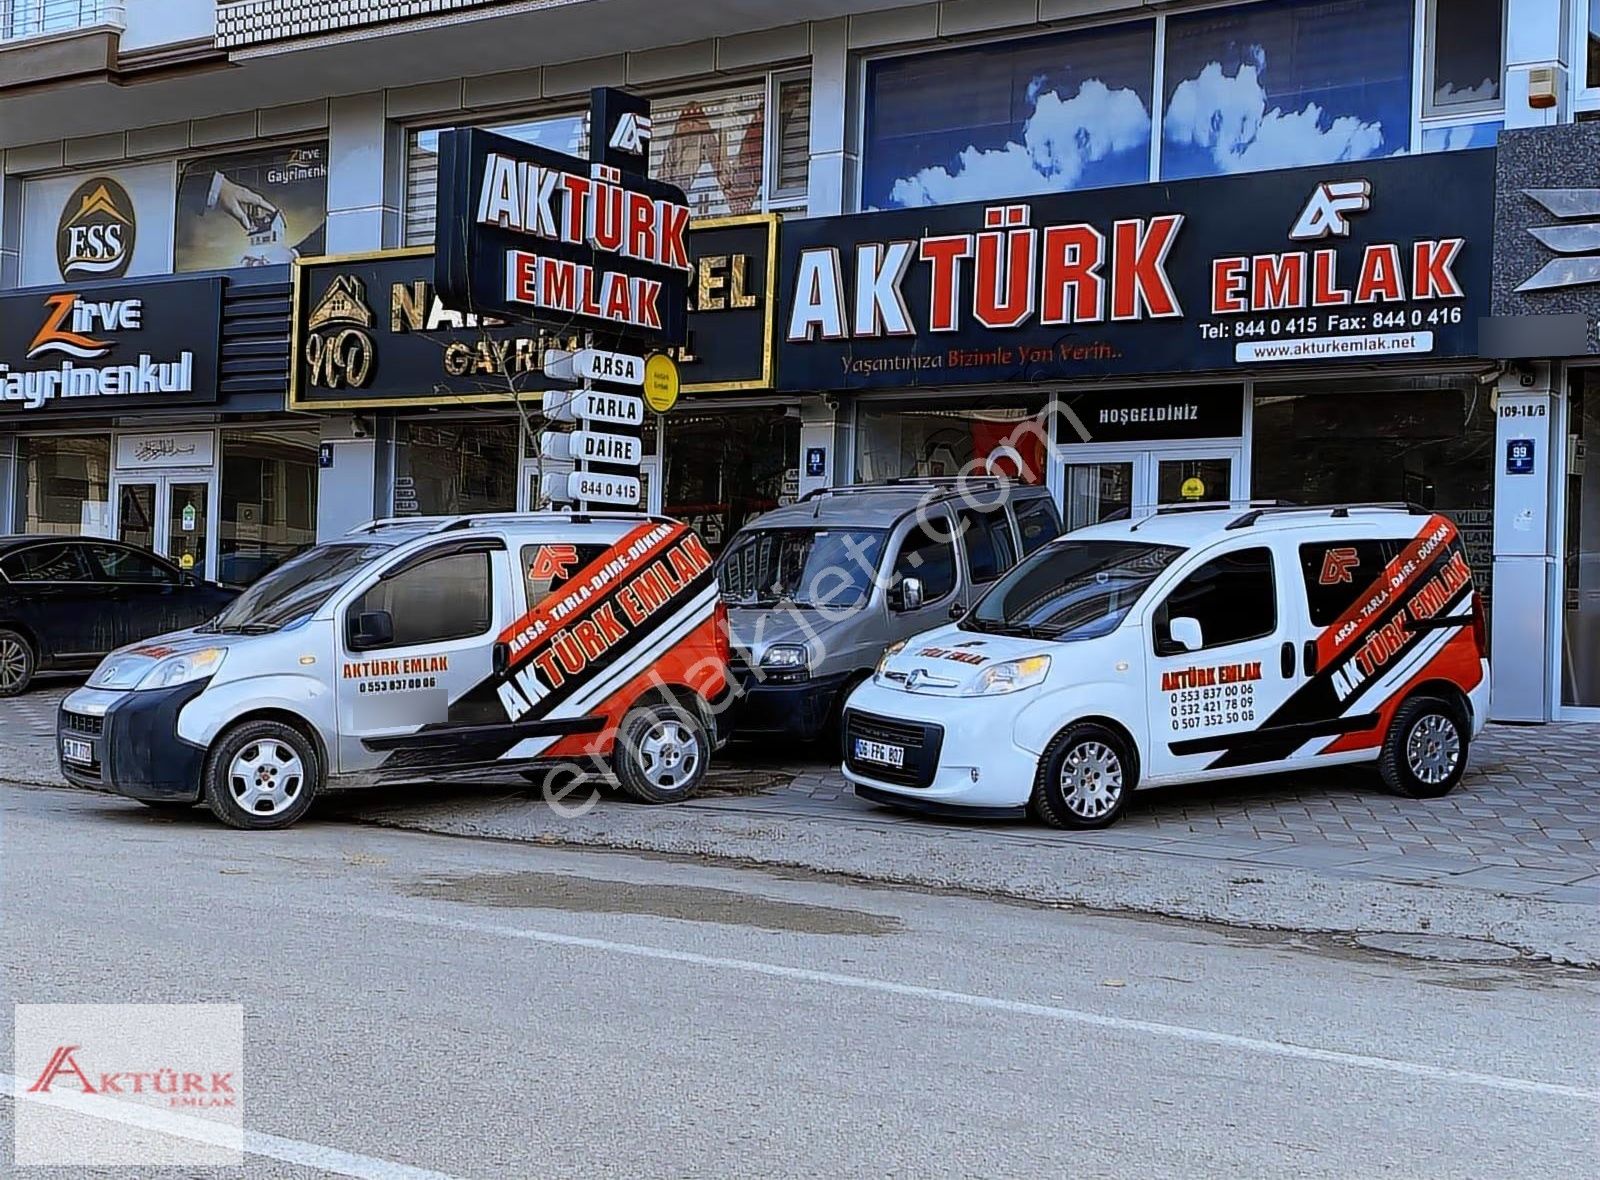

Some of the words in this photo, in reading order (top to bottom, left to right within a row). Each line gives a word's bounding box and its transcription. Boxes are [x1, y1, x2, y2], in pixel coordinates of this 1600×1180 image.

[476, 152, 692, 272] AKTÜRK
[66, 223, 125, 263] ESS
[786, 203, 1185, 343] AKTÜRK
[1211, 237, 1465, 315] EMLAK
[506, 248, 662, 330] EMLAK
[1200, 323, 1230, 339] Tel:
[1235, 321, 1266, 337] 844
[1271, 319, 1282, 335] 0
[1286, 316, 1318, 334] 415
[1327, 314, 1367, 331] Fax:
[1372, 311, 1406, 328] 844
[1411, 310, 1422, 326] 0
[1427, 307, 1462, 324] 416
[948, 348, 1012, 368] Bizimle
[1254, 335, 1416, 358] www.akturkemlak.net
[592, 355, 635, 379] ARSA
[587, 396, 637, 420] TARLA
[1099, 403, 1198, 426] HOŞGELDİNİZ
[585, 437, 633, 460] DAİRE
[580, 480, 602, 495] 844
[605, 483, 613, 496] 0
[616, 484, 636, 499] 415
[497, 601, 629, 722] AKTÜRK
[615, 532, 713, 627] EMLAK
[1331, 608, 1416, 702] AKTÜRK
[343, 659, 400, 679] AKTÜRK
[403, 656, 448, 674] EMLAK
[1162, 666, 1216, 691] AKTÜRK
[1218, 662, 1262, 684] EMLAK
[1170, 693, 1178, 703] 0
[1181, 690, 1200, 702] 553
[1203, 688, 1221, 699] 837
[1225, 685, 1239, 696] 00
[1170, 706, 1178, 716] 0
[1181, 703, 1200, 715] 532
[1203, 701, 1220, 711] 421
[1225, 699, 1238, 710] 78
[1172, 719, 1179, 730] 0
[1182, 717, 1201, 729] 507
[1204, 714, 1223, 726] 352
[1226, 712, 1239, 723] 50
